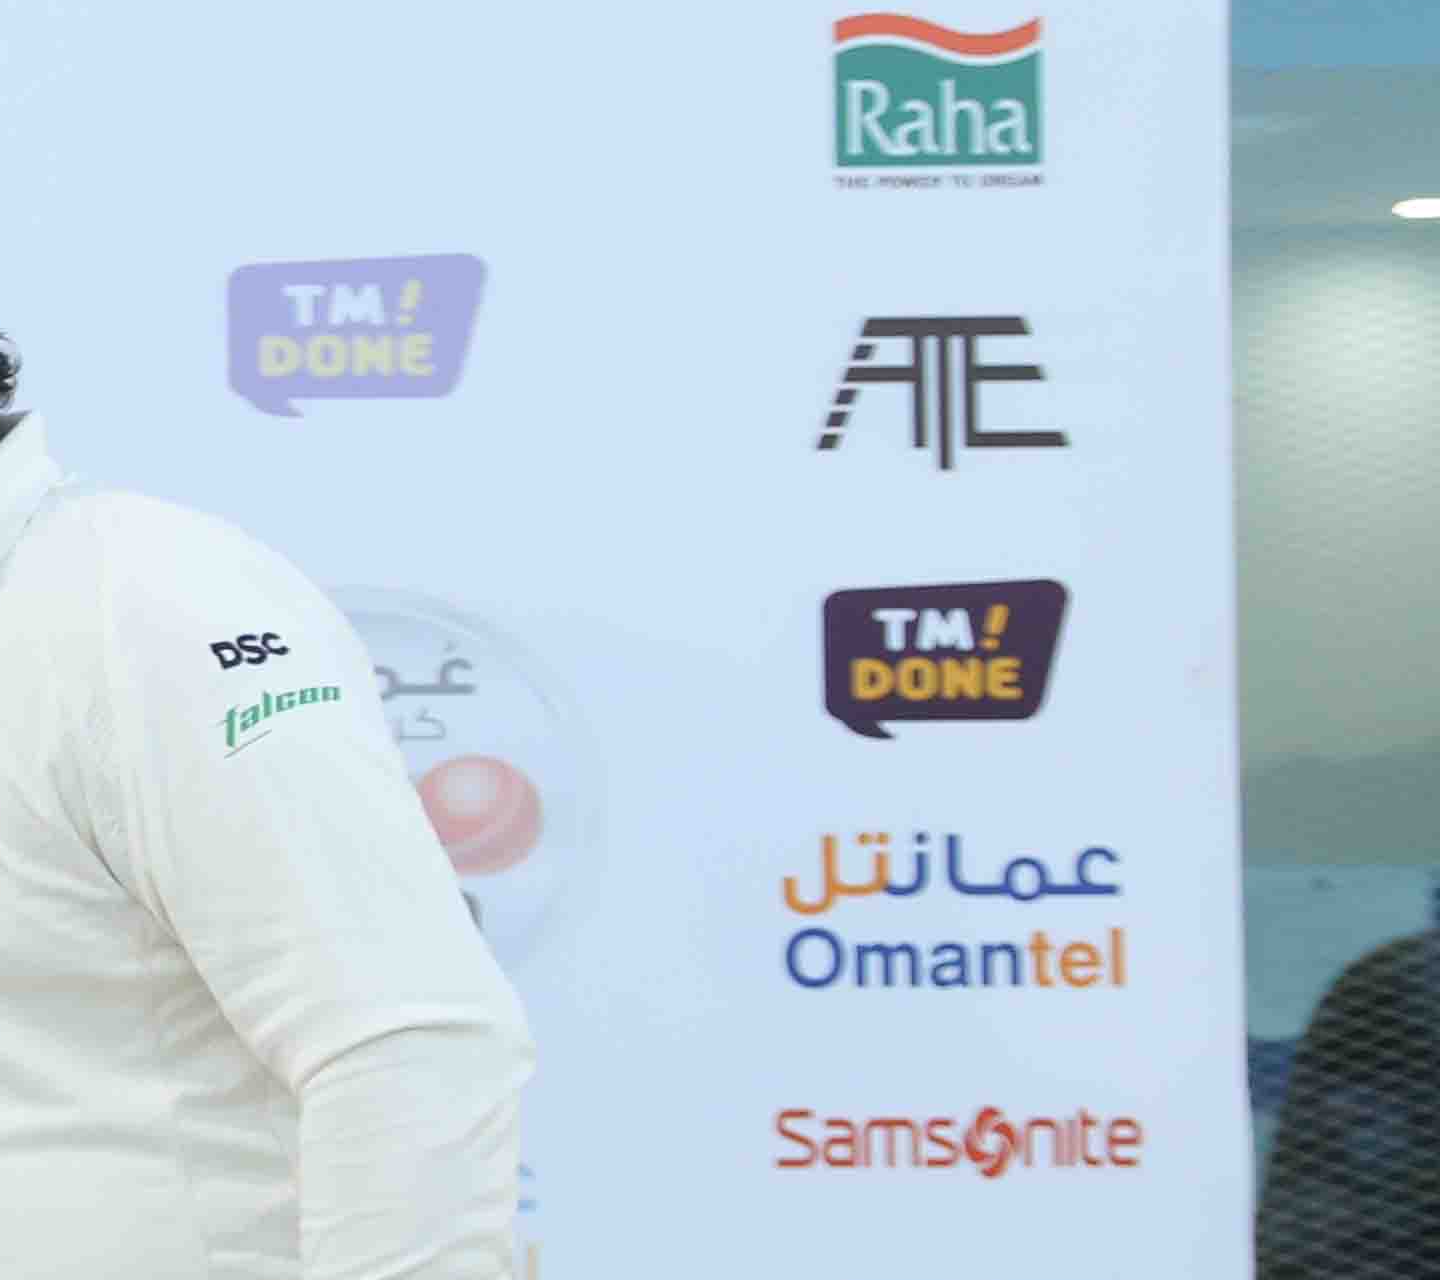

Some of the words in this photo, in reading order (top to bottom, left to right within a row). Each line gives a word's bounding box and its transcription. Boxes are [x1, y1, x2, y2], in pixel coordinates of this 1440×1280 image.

[846, 79, 1032, 156] Raha
[259, 333, 436, 379] DONE
[209, 632, 290, 670] DSC
[851, 658, 1024, 703] DONE
[783, 831, 1121, 915] عمانتل
[786, 927, 1126, 988] Omantel
[775, 1106, 1143, 1179] Samsonite
